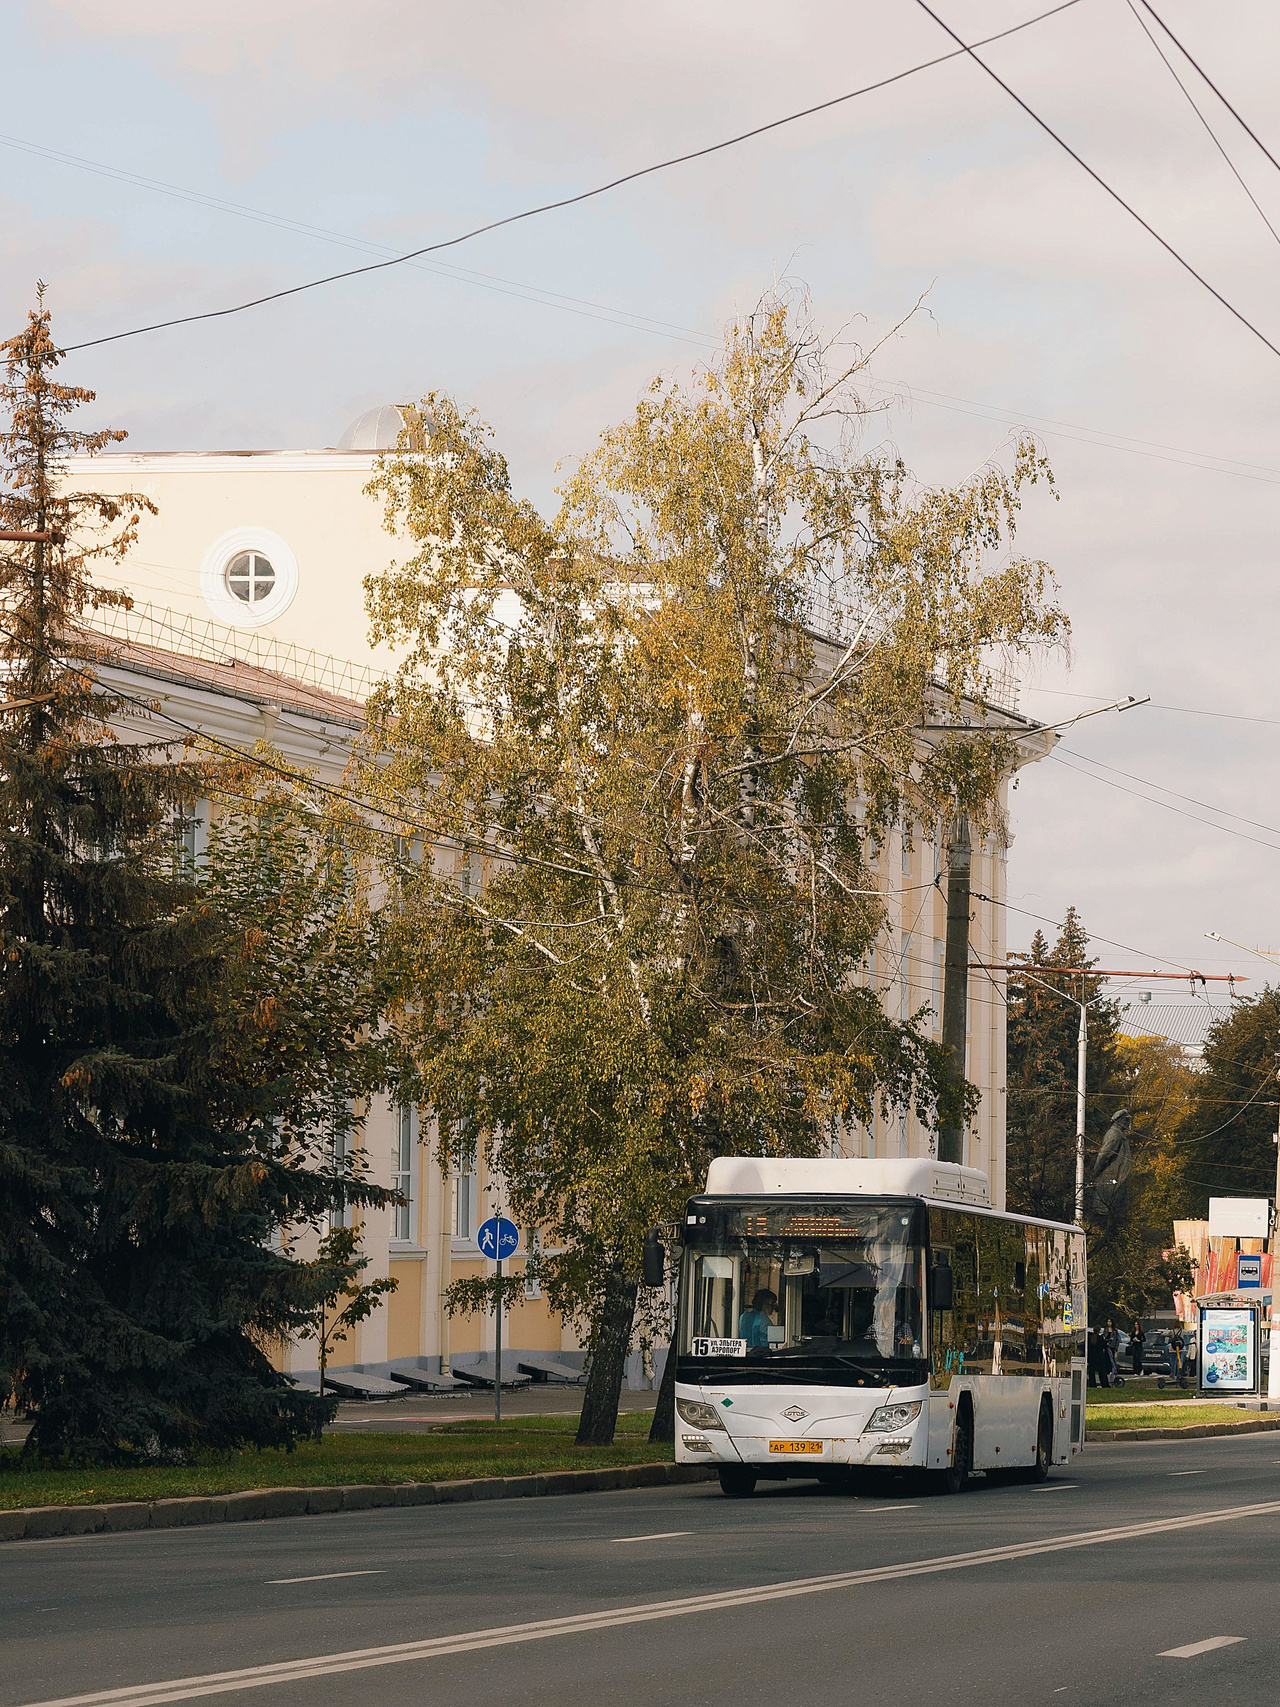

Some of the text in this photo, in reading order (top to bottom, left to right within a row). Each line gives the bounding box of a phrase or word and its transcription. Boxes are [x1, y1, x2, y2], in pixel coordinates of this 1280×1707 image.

[693, 1338, 709, 1356] 15
[711, 1346, 740, 1354] АЭРОПОРТ
[789, 1442, 806, 1452] 139
[810, 1442, 820, 1450] 21
